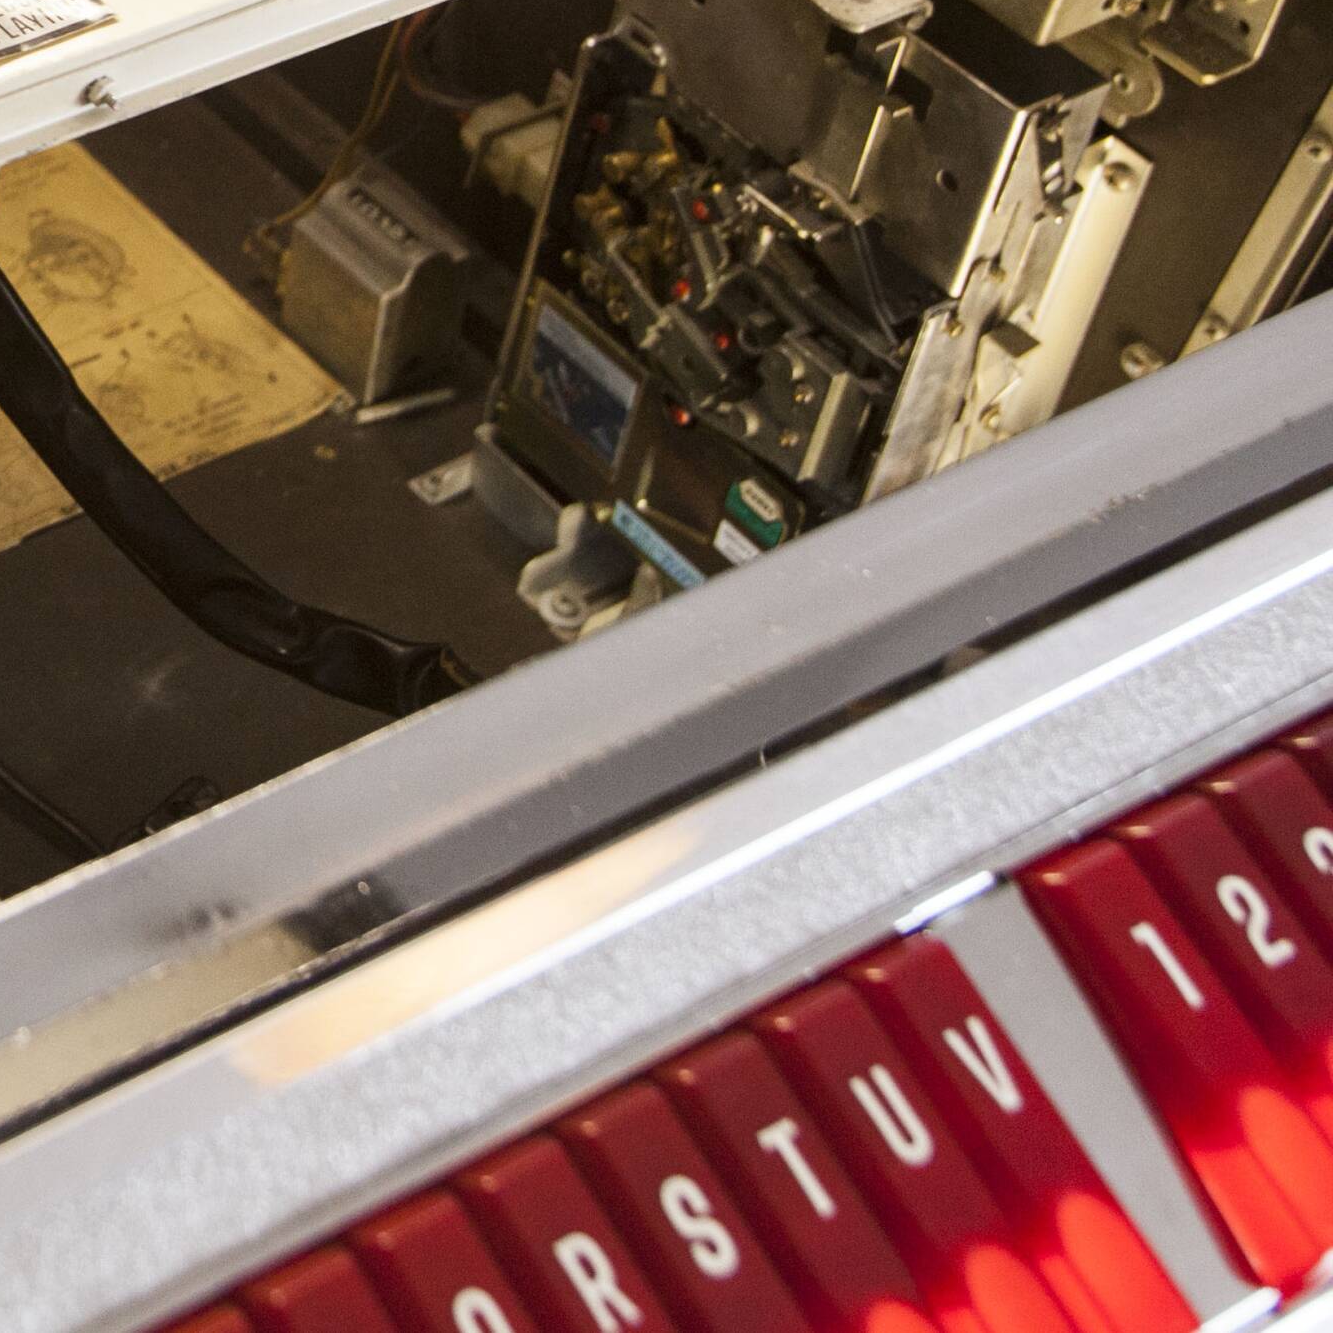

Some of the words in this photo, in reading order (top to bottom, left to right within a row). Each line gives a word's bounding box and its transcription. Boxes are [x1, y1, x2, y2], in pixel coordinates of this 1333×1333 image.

[1130, 921, 1205, 1010] 1
[1216, 874, 1297, 969] 2
[552, 1231, 644, 1333] R
[659, 1174, 740, 1279] S
[756, 1117, 836, 1219] T
[849, 1063, 935, 1166] U
[941, 1014, 1024, 1114] V
